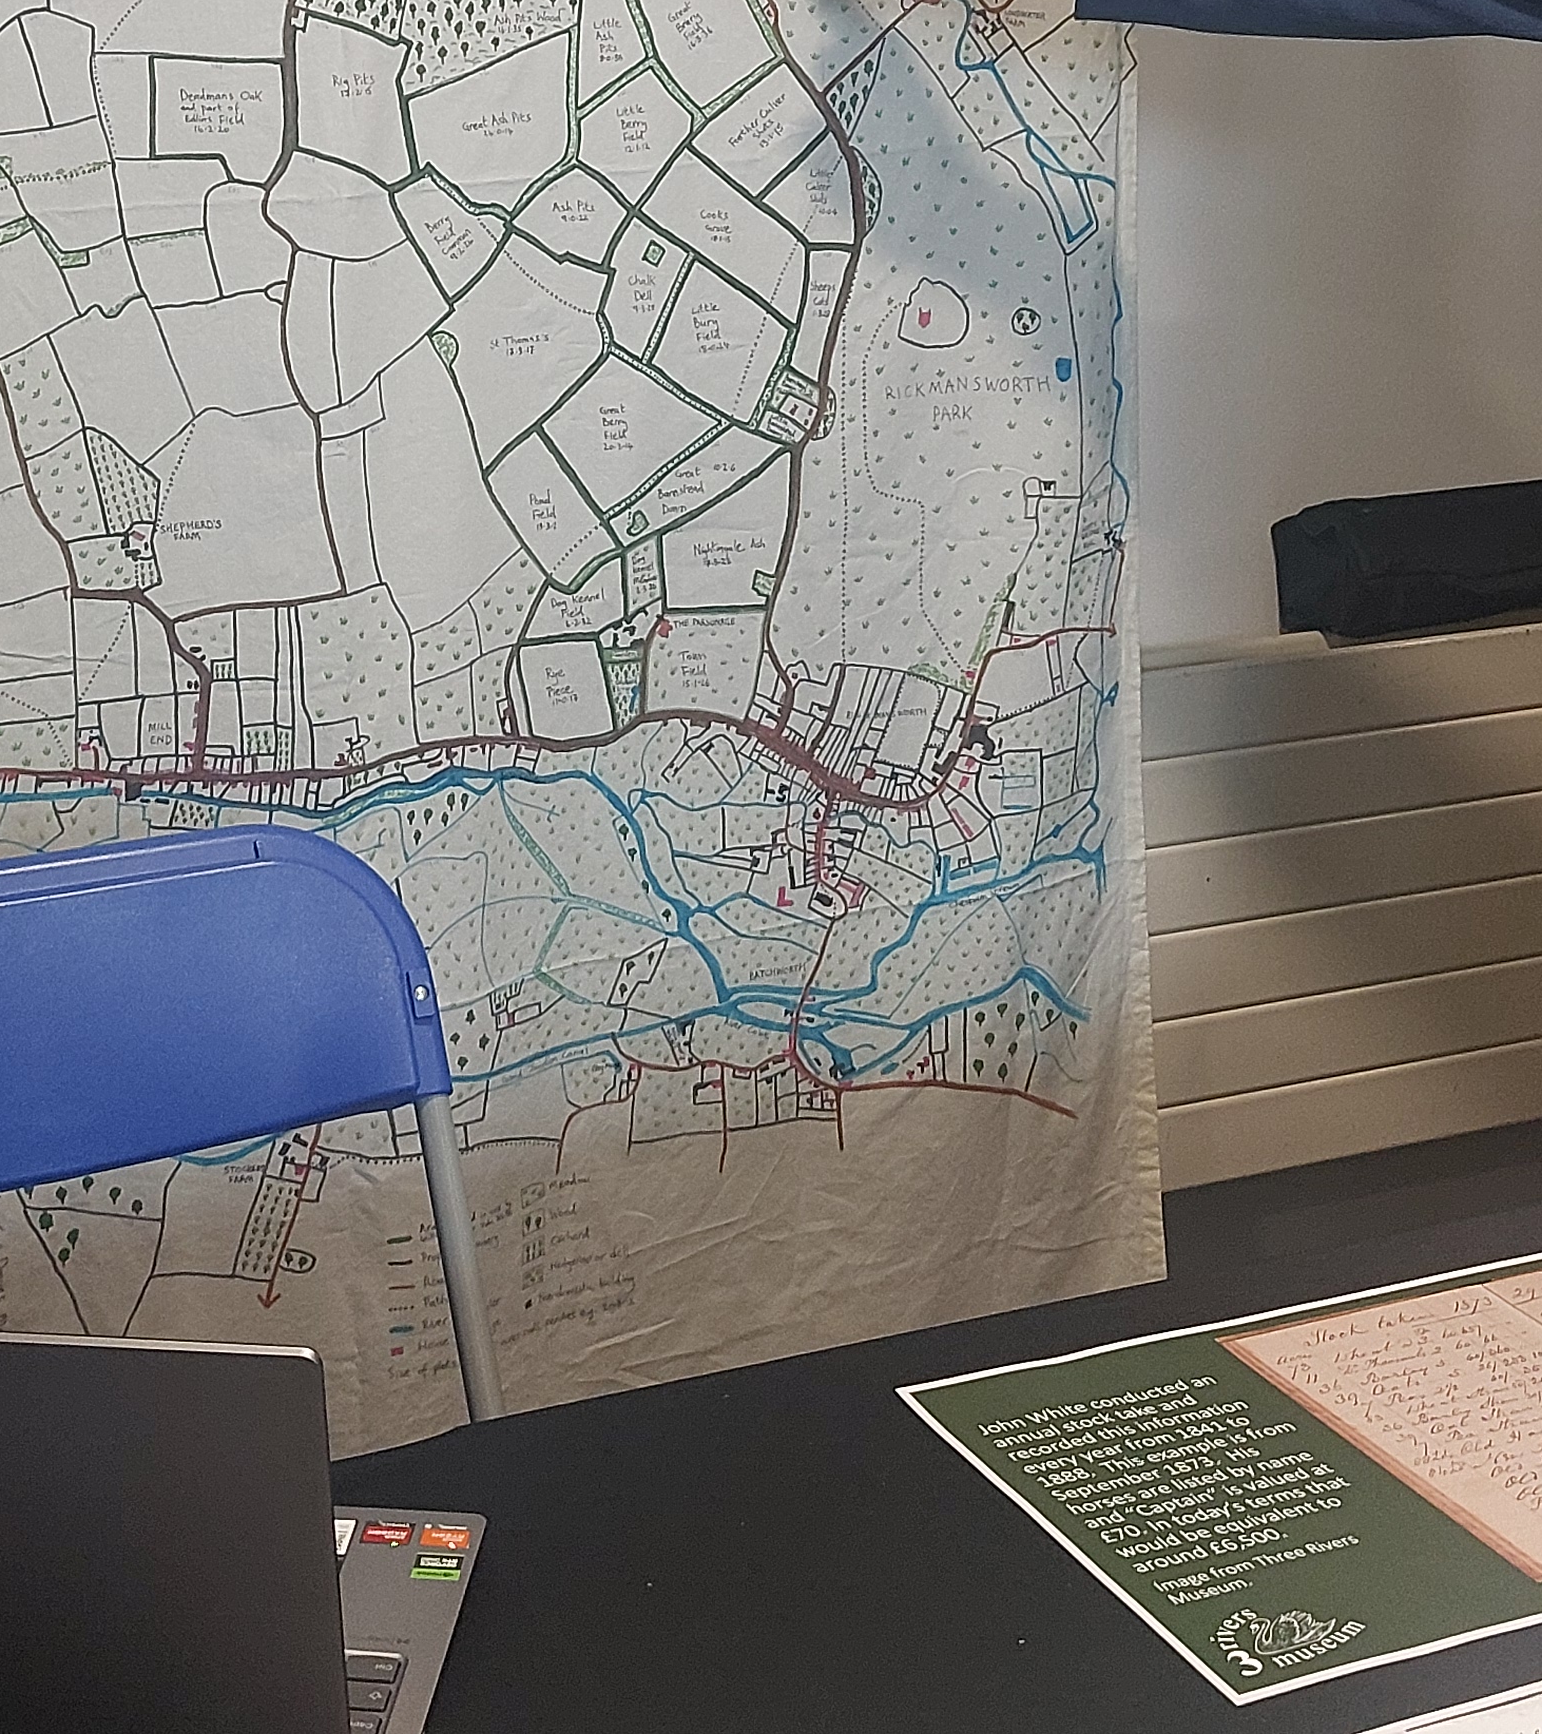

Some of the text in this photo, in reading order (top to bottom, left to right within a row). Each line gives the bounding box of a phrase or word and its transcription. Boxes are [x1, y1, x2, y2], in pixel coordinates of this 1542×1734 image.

[884, 375, 1052, 400] RICKMANSWORTH
[932, 404, 973, 422] PARK
[148, 722, 172, 733] MILL
[150, 734, 173, 746] END
[975, 1374, 1219, 1437] John White conducted an
[990, 1391, 1199, 1449] annual stock take and
[1005, 1399, 1251, 1463] recorded this information
[1049, 1466, 1163, 1503] September
[1222, 1445, 1262, 1463] His
[1095, 1453, 1146, 1474] This
[1144, 1435, 1230, 1464] example
[1223, 1431, 1249, 1446] is
[1243, 1420, 1298, 1441] from
[1081, 1461, 1336, 1530] and "Captain" is valued at
[1129, 1542, 1210, 1574] around
[1151, 1533, 1361, 1594] Image from Three Rivers
[1209, 1608, 1263, 1677] 3 rivers
[1271, 1620, 1367, 1668] museum
